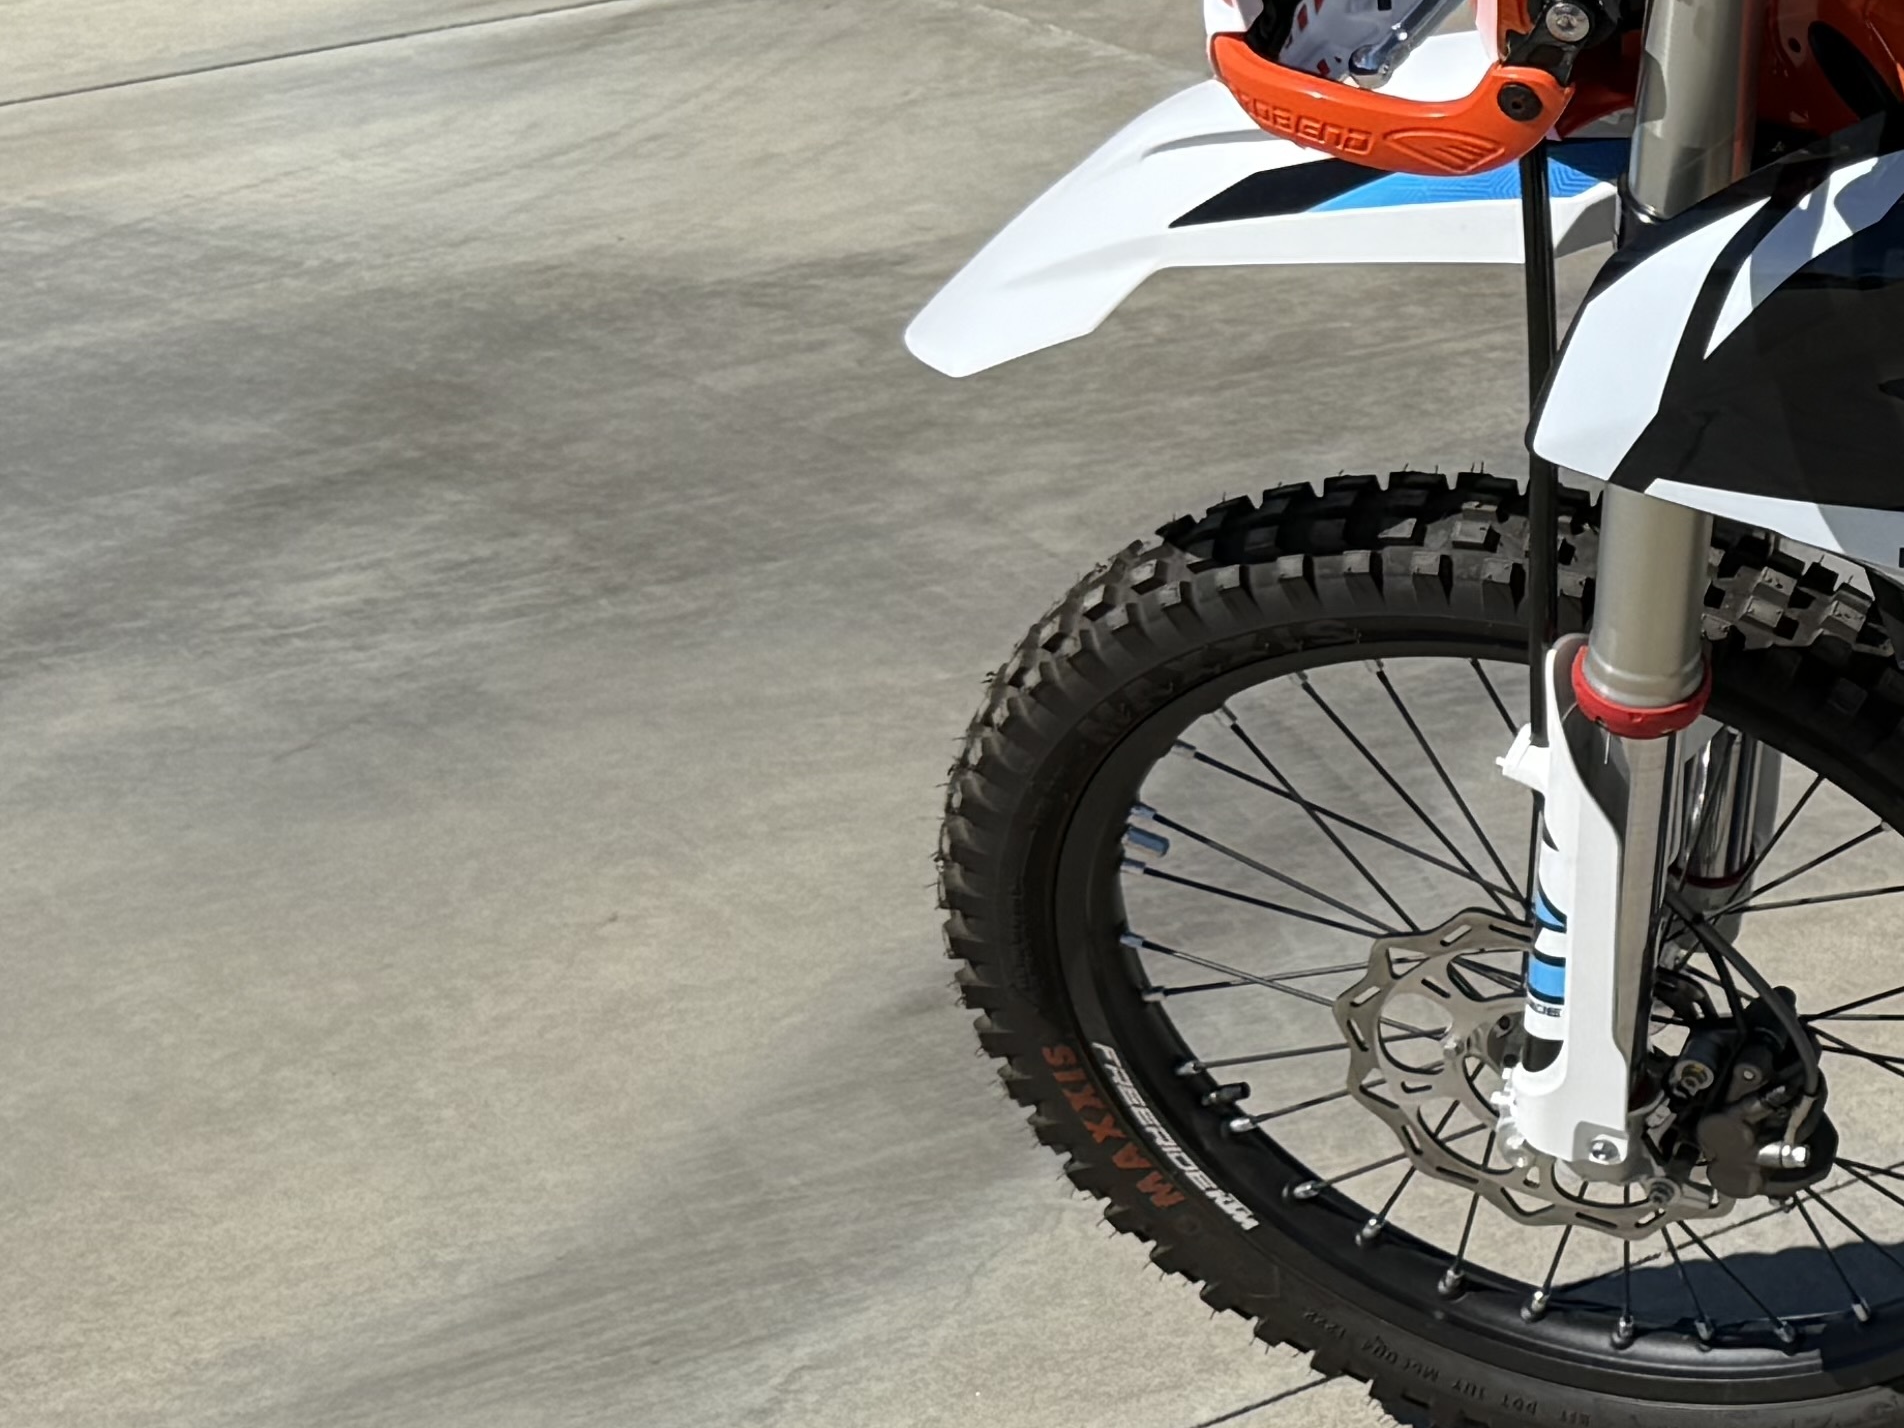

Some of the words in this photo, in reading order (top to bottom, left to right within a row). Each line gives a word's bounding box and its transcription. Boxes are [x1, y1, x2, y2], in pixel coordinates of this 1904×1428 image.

[1043, 1044, 1185, 1209] MAXXIS
[1092, 1043, 1219, 1193] FREERIDE
[1208, 1190, 1260, 1231] KTM
[1498, 1391, 1539, 1417] DOT
